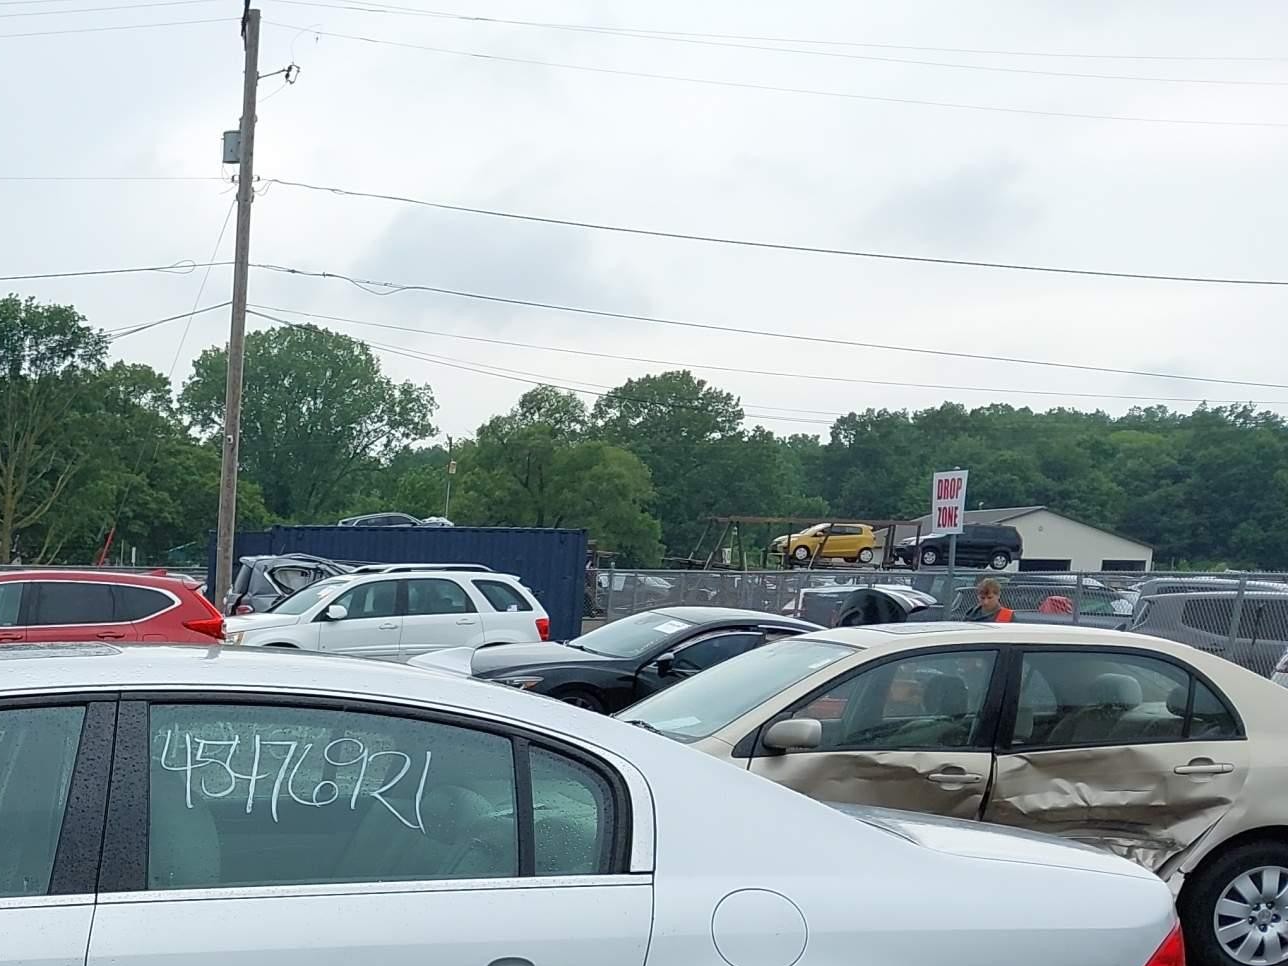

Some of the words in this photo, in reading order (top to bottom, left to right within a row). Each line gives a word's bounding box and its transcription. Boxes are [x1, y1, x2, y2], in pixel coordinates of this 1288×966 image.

[937, 478, 962, 500] DROP
[937, 506, 958, 528] ZONE
[161, 730, 432, 834] 45476921
